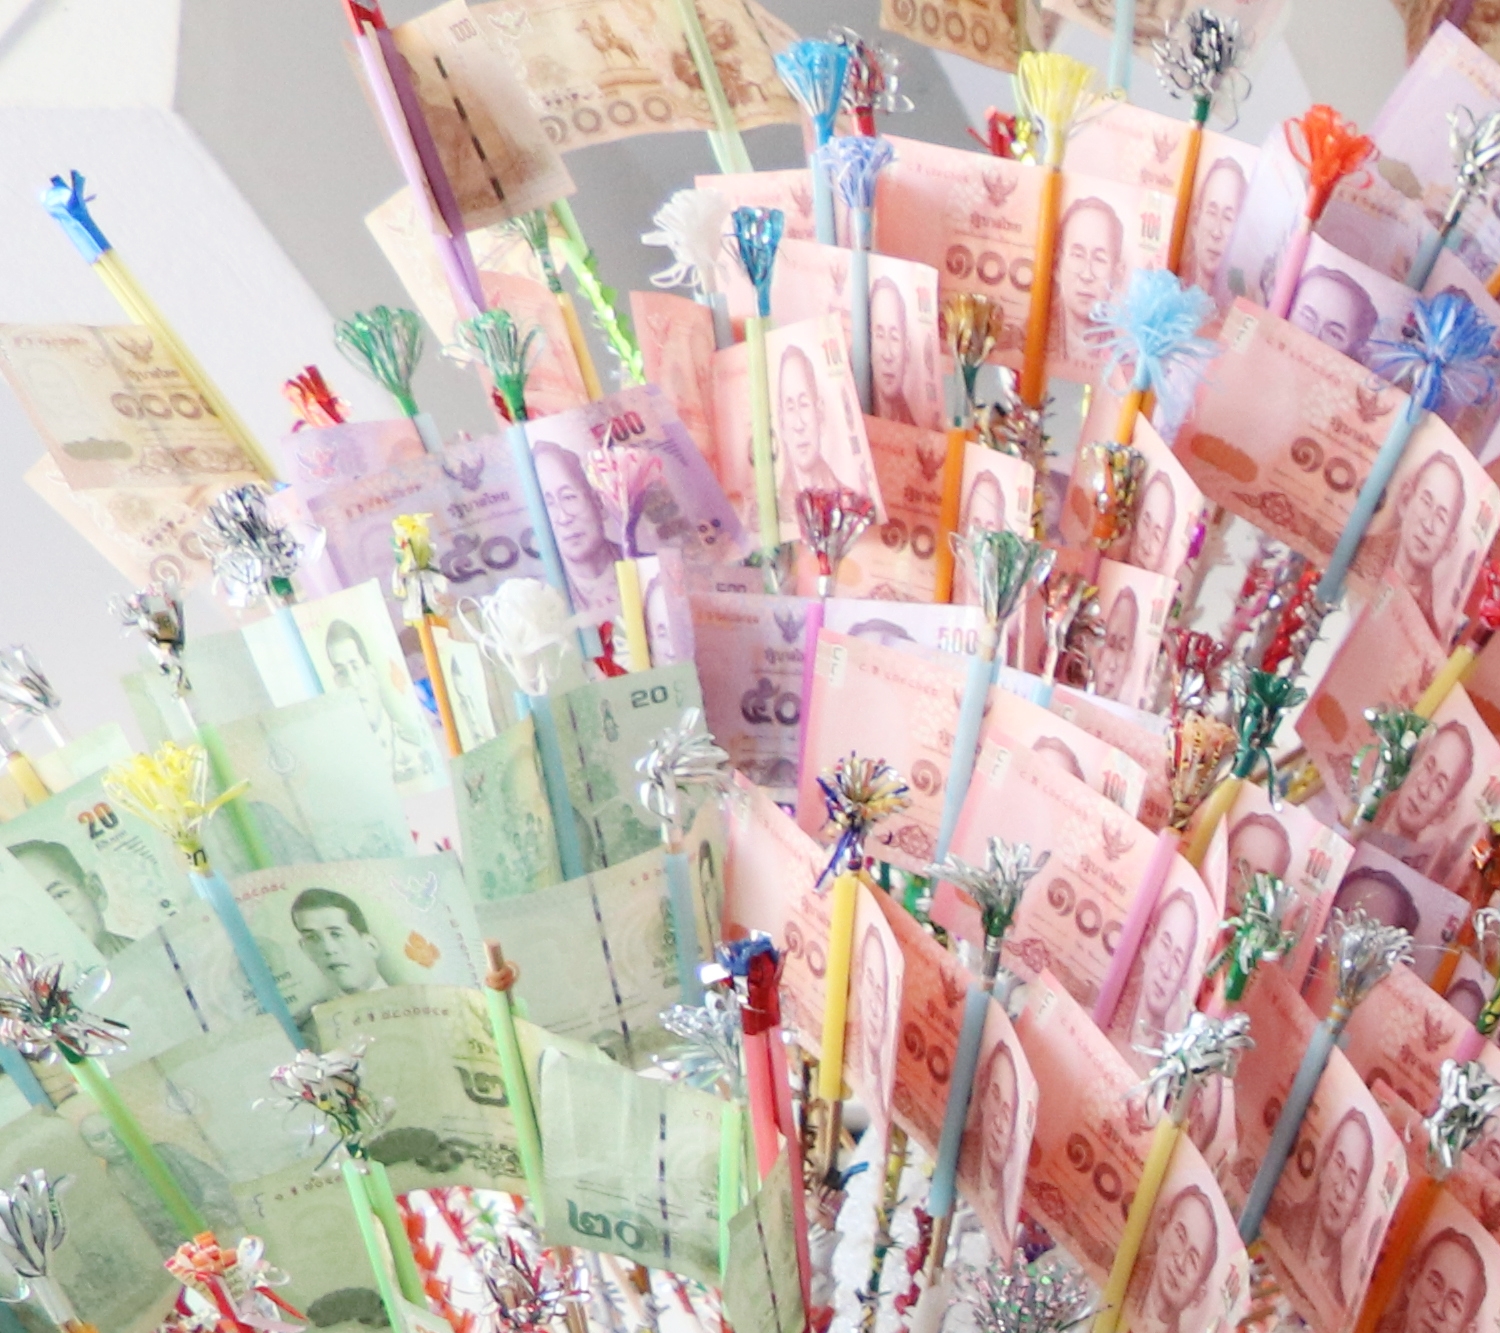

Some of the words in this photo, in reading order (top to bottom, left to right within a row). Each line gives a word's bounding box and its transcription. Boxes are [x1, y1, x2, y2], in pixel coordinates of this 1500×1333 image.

[881, 518, 936, 559] ๑๐
[631, 685, 669, 708] 20
[78, 801, 121, 840] 20
[784, 919, 827, 978] ๑๐
[903, 1021, 951, 1086] ๑๐
